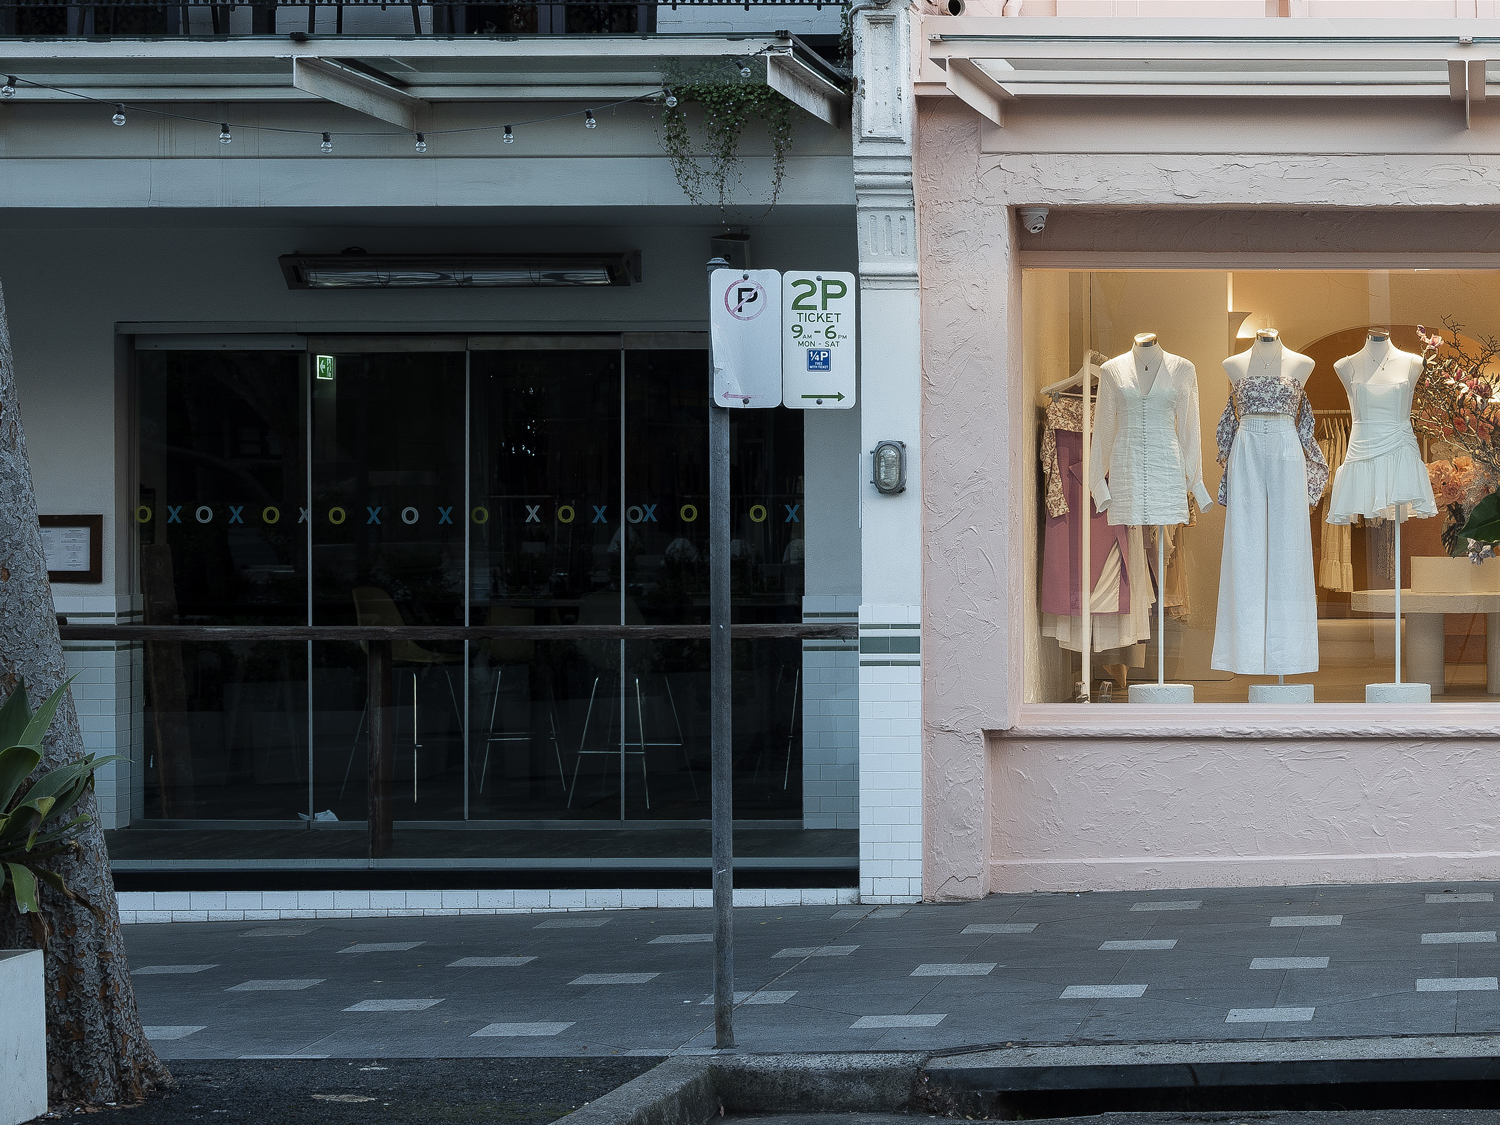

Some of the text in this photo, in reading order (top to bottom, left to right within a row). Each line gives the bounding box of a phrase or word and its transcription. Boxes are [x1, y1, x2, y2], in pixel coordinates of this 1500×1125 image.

[737, 287, 759, 313] P
[791, 279, 847, 310] 2P
[797, 312, 841, 323] TICKET
